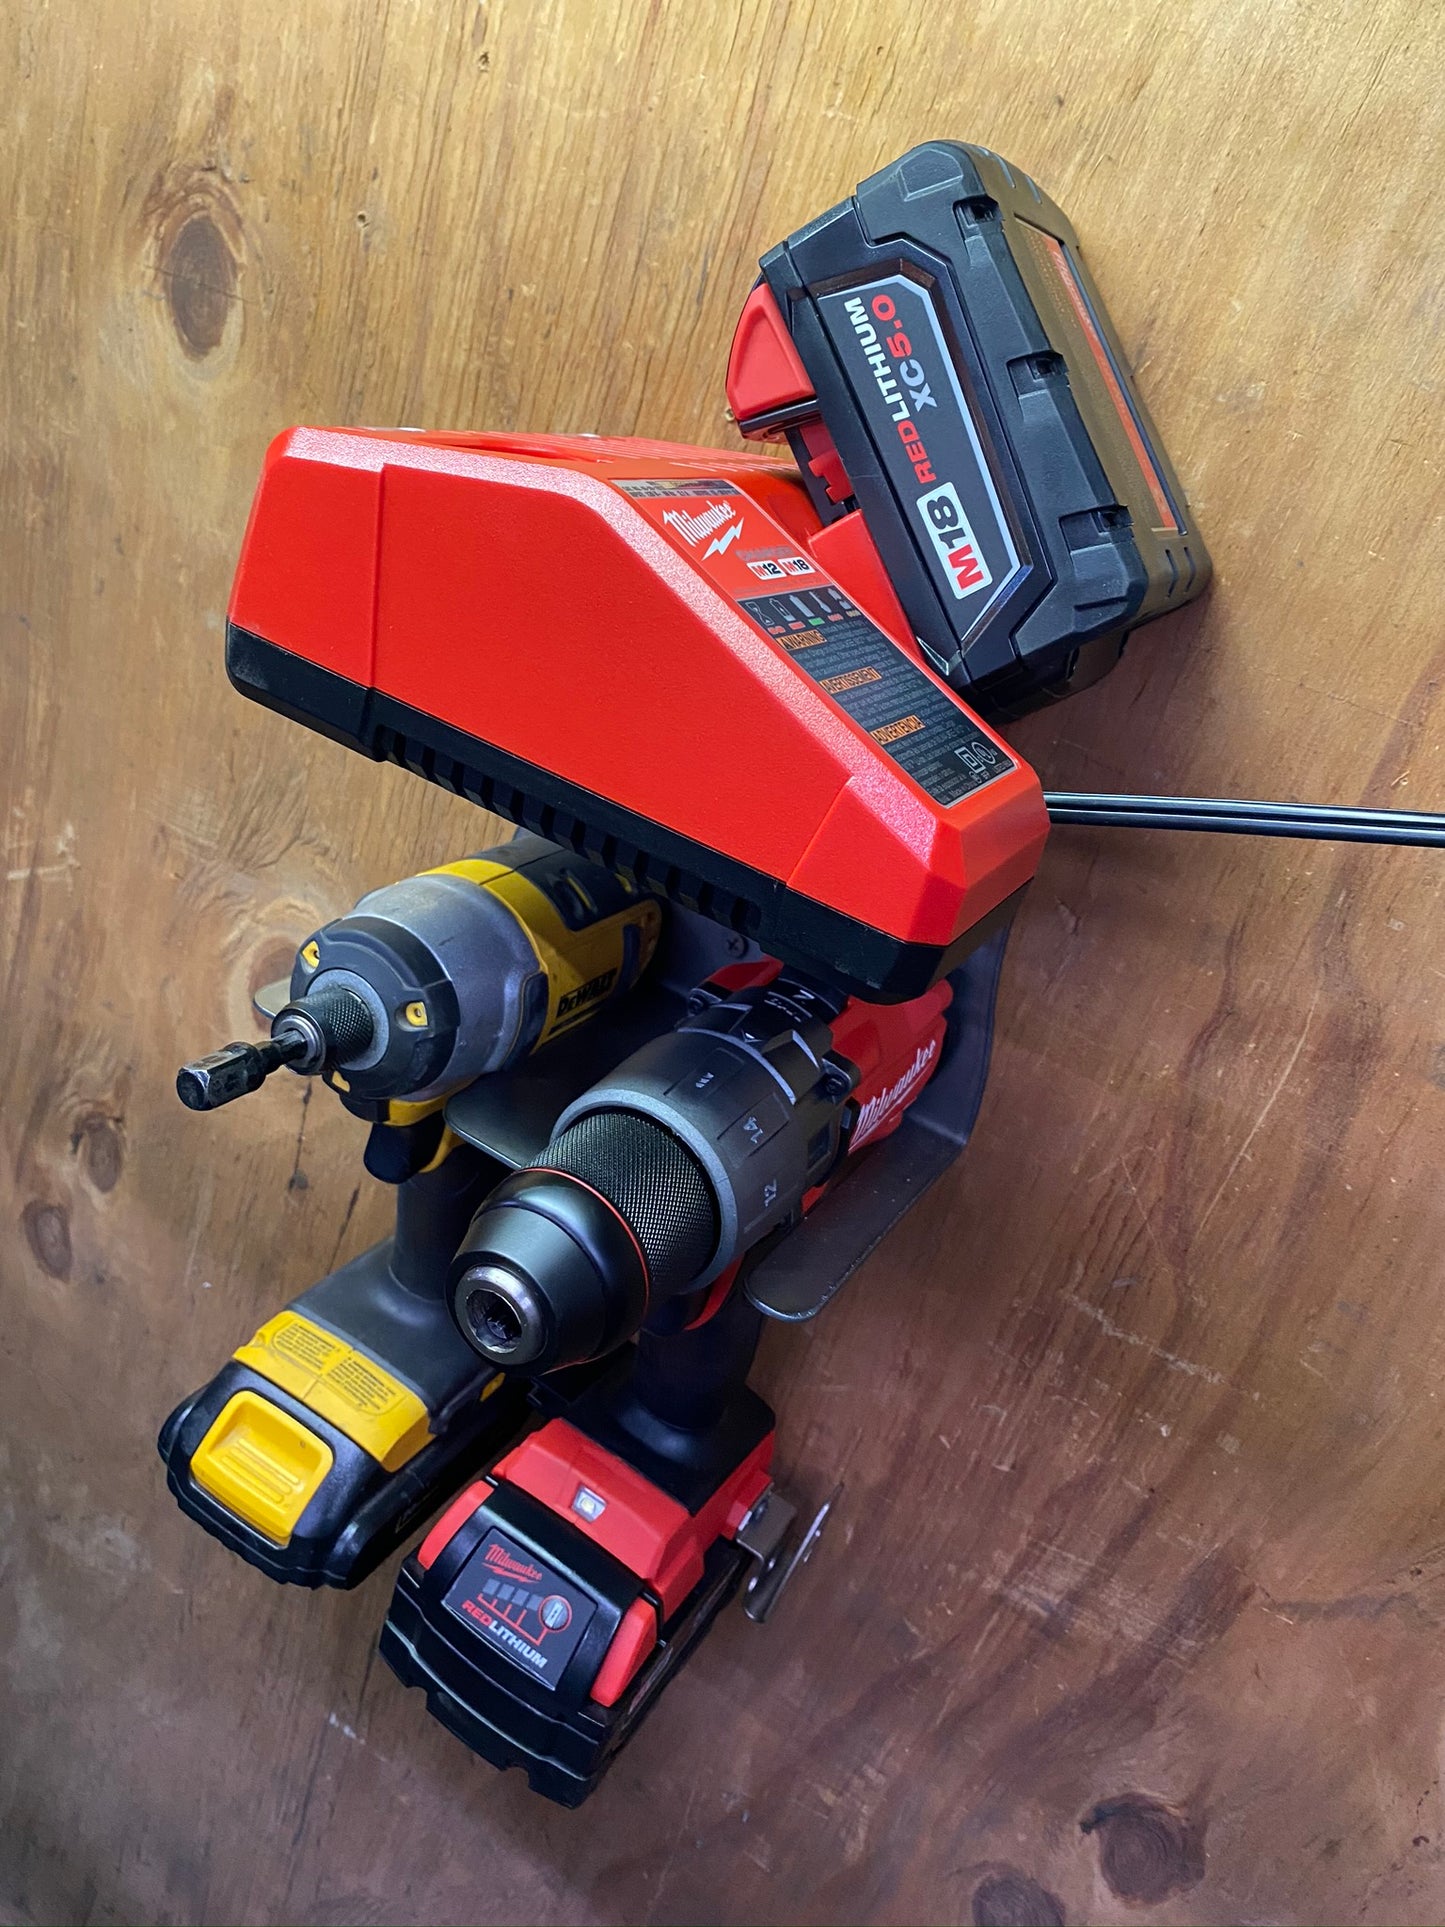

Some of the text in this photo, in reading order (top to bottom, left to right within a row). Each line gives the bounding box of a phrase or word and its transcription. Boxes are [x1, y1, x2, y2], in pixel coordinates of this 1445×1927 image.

[872, 294, 938, 412] XC5.0
[844, 297, 984, 590] M18 REDLITHIUM
[663, 500, 736, 547] Milwaukee
[751, 559, 810, 577] M12 M18
[849, 1039, 935, 1149] Milwaukee
[484, 1543, 542, 1580] Milwaukee
[462, 1600, 548, 1668] REDLITHIUM
